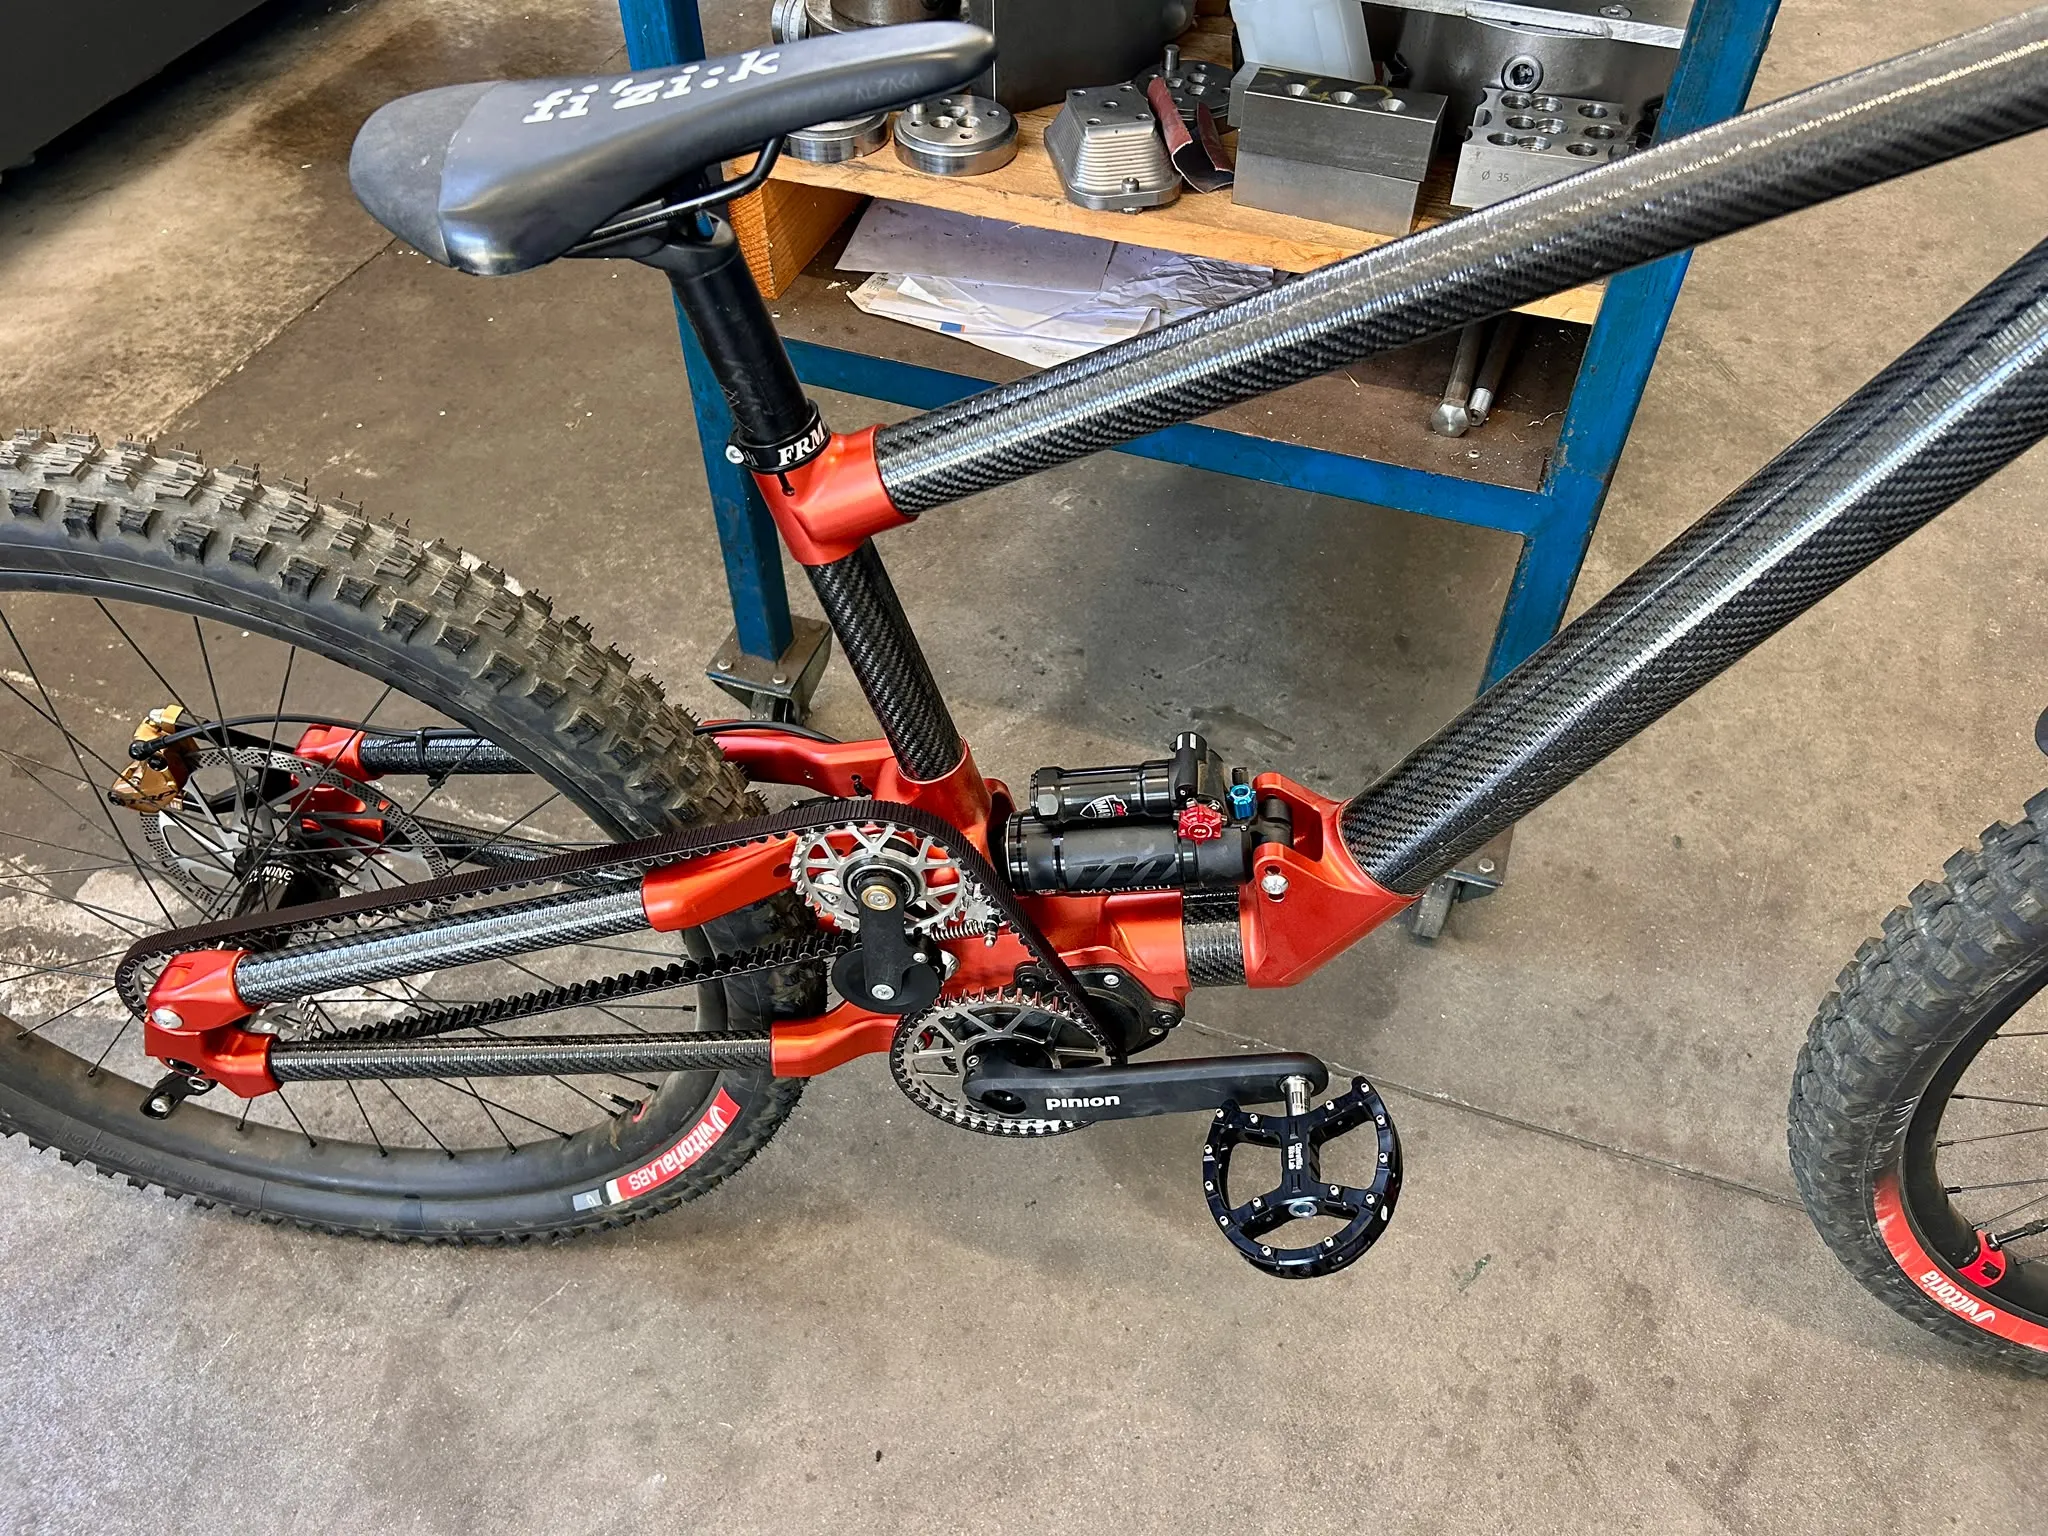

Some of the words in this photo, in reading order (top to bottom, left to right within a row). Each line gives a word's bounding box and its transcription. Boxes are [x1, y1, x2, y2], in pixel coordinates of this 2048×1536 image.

[1497, 172, 1509, 182] 35
[1080, 884, 1171, 894] MANITOU
[1046, 1096, 1120, 1111] pinion
[1919, 1269, 1982, 1318] vittoria
